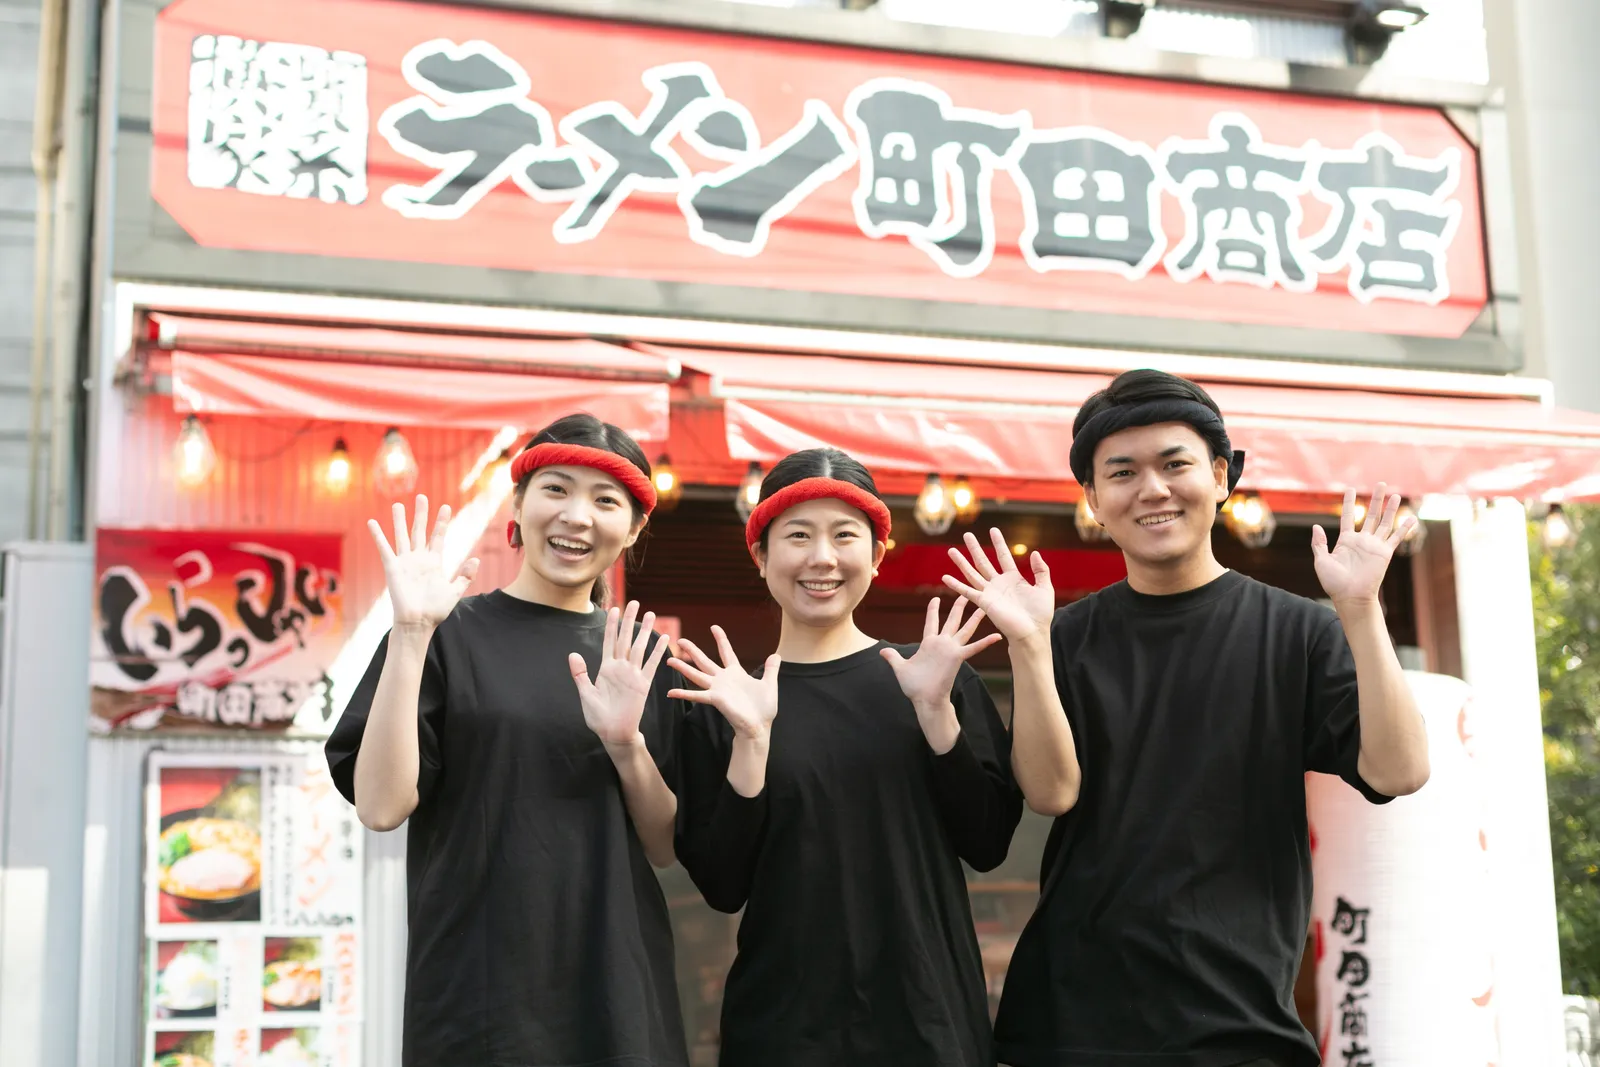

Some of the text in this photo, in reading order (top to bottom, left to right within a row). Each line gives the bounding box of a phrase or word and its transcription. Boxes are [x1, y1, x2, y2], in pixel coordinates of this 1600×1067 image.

[380, 38, 1462, 307] ラーメン町田商店
